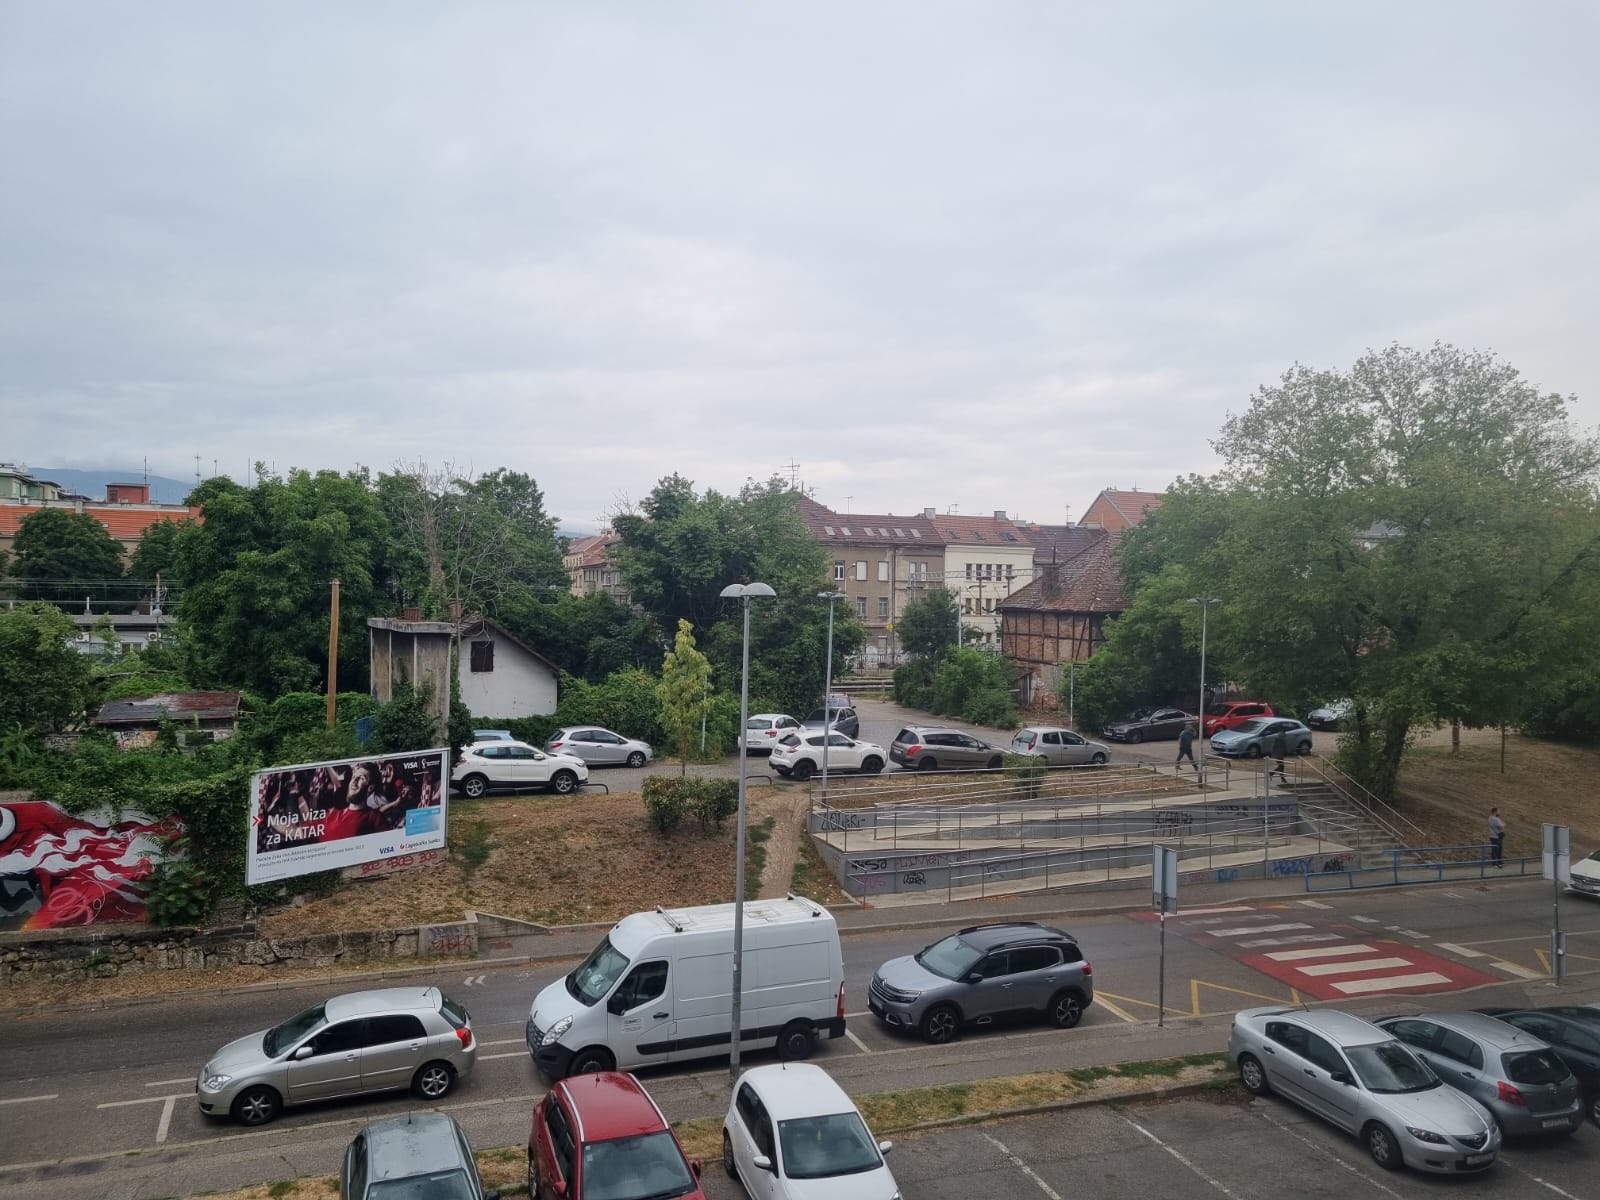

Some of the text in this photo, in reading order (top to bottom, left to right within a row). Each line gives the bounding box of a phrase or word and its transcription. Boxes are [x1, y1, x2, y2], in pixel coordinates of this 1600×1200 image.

[403, 761, 418, 770] VISA
[267, 808, 326, 828] Moja viza
[266, 823, 326, 845] za KATAR
[379, 846, 395, 854] VISA
